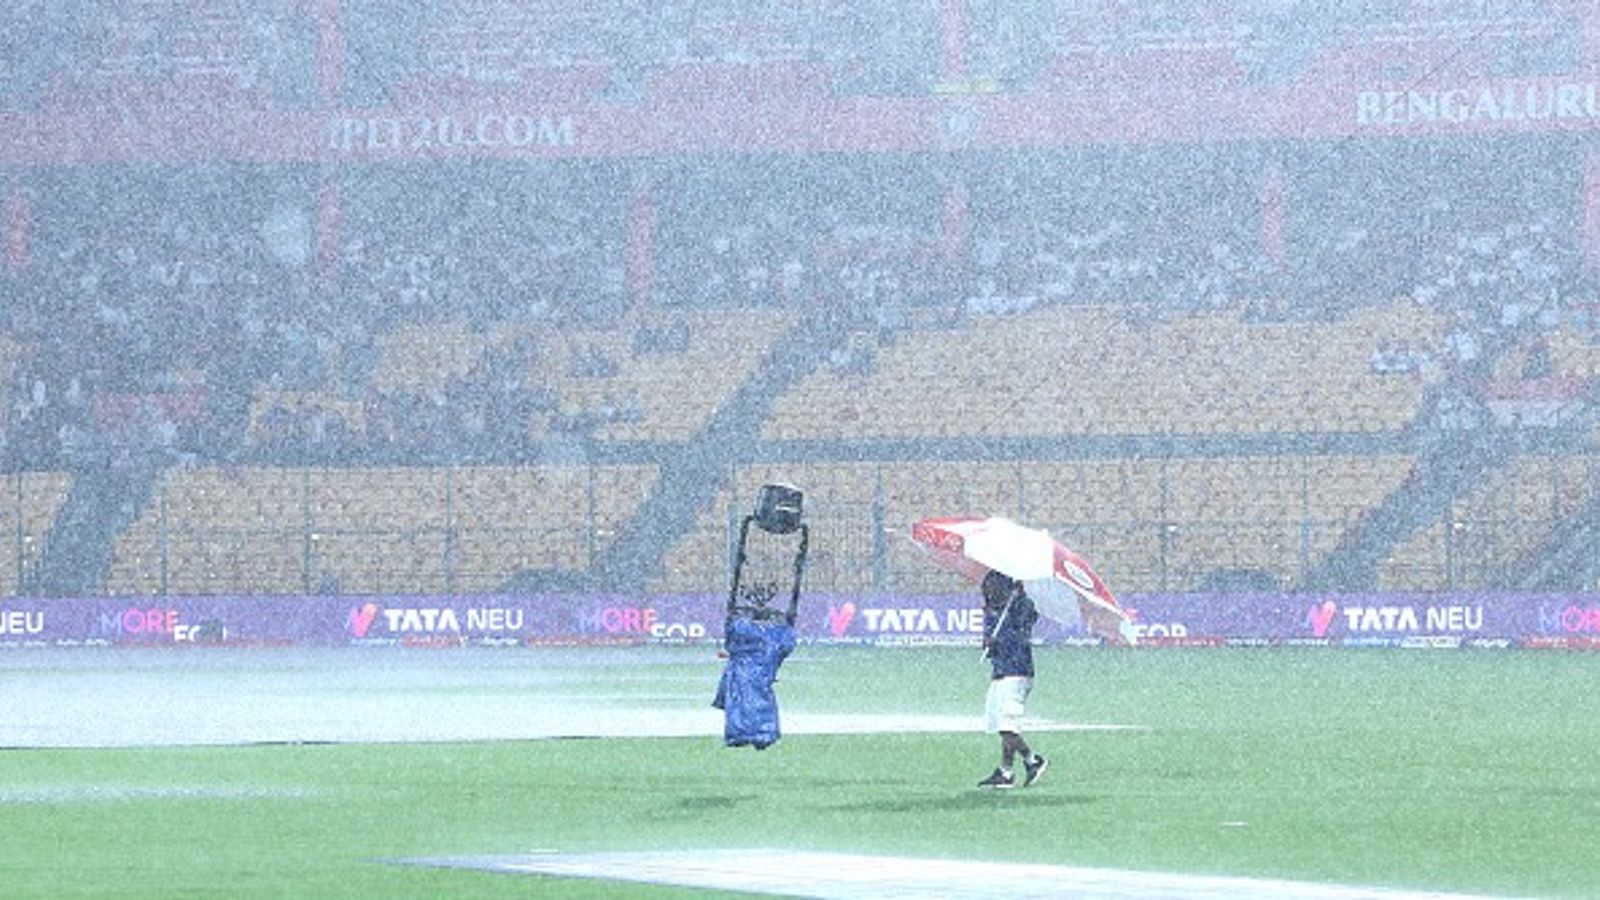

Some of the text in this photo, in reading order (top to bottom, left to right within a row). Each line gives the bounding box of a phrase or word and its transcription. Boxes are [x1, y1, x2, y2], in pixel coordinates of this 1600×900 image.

[101, 609, 179, 634] MORE
[384, 609, 524, 631] TATA NEU
[577, 608, 657, 632] MORE
[863, 609, 983, 632] TATA NE
[1344, 606, 1483, 630] TATA NEU
[1540, 606, 1600, 632] MOR
